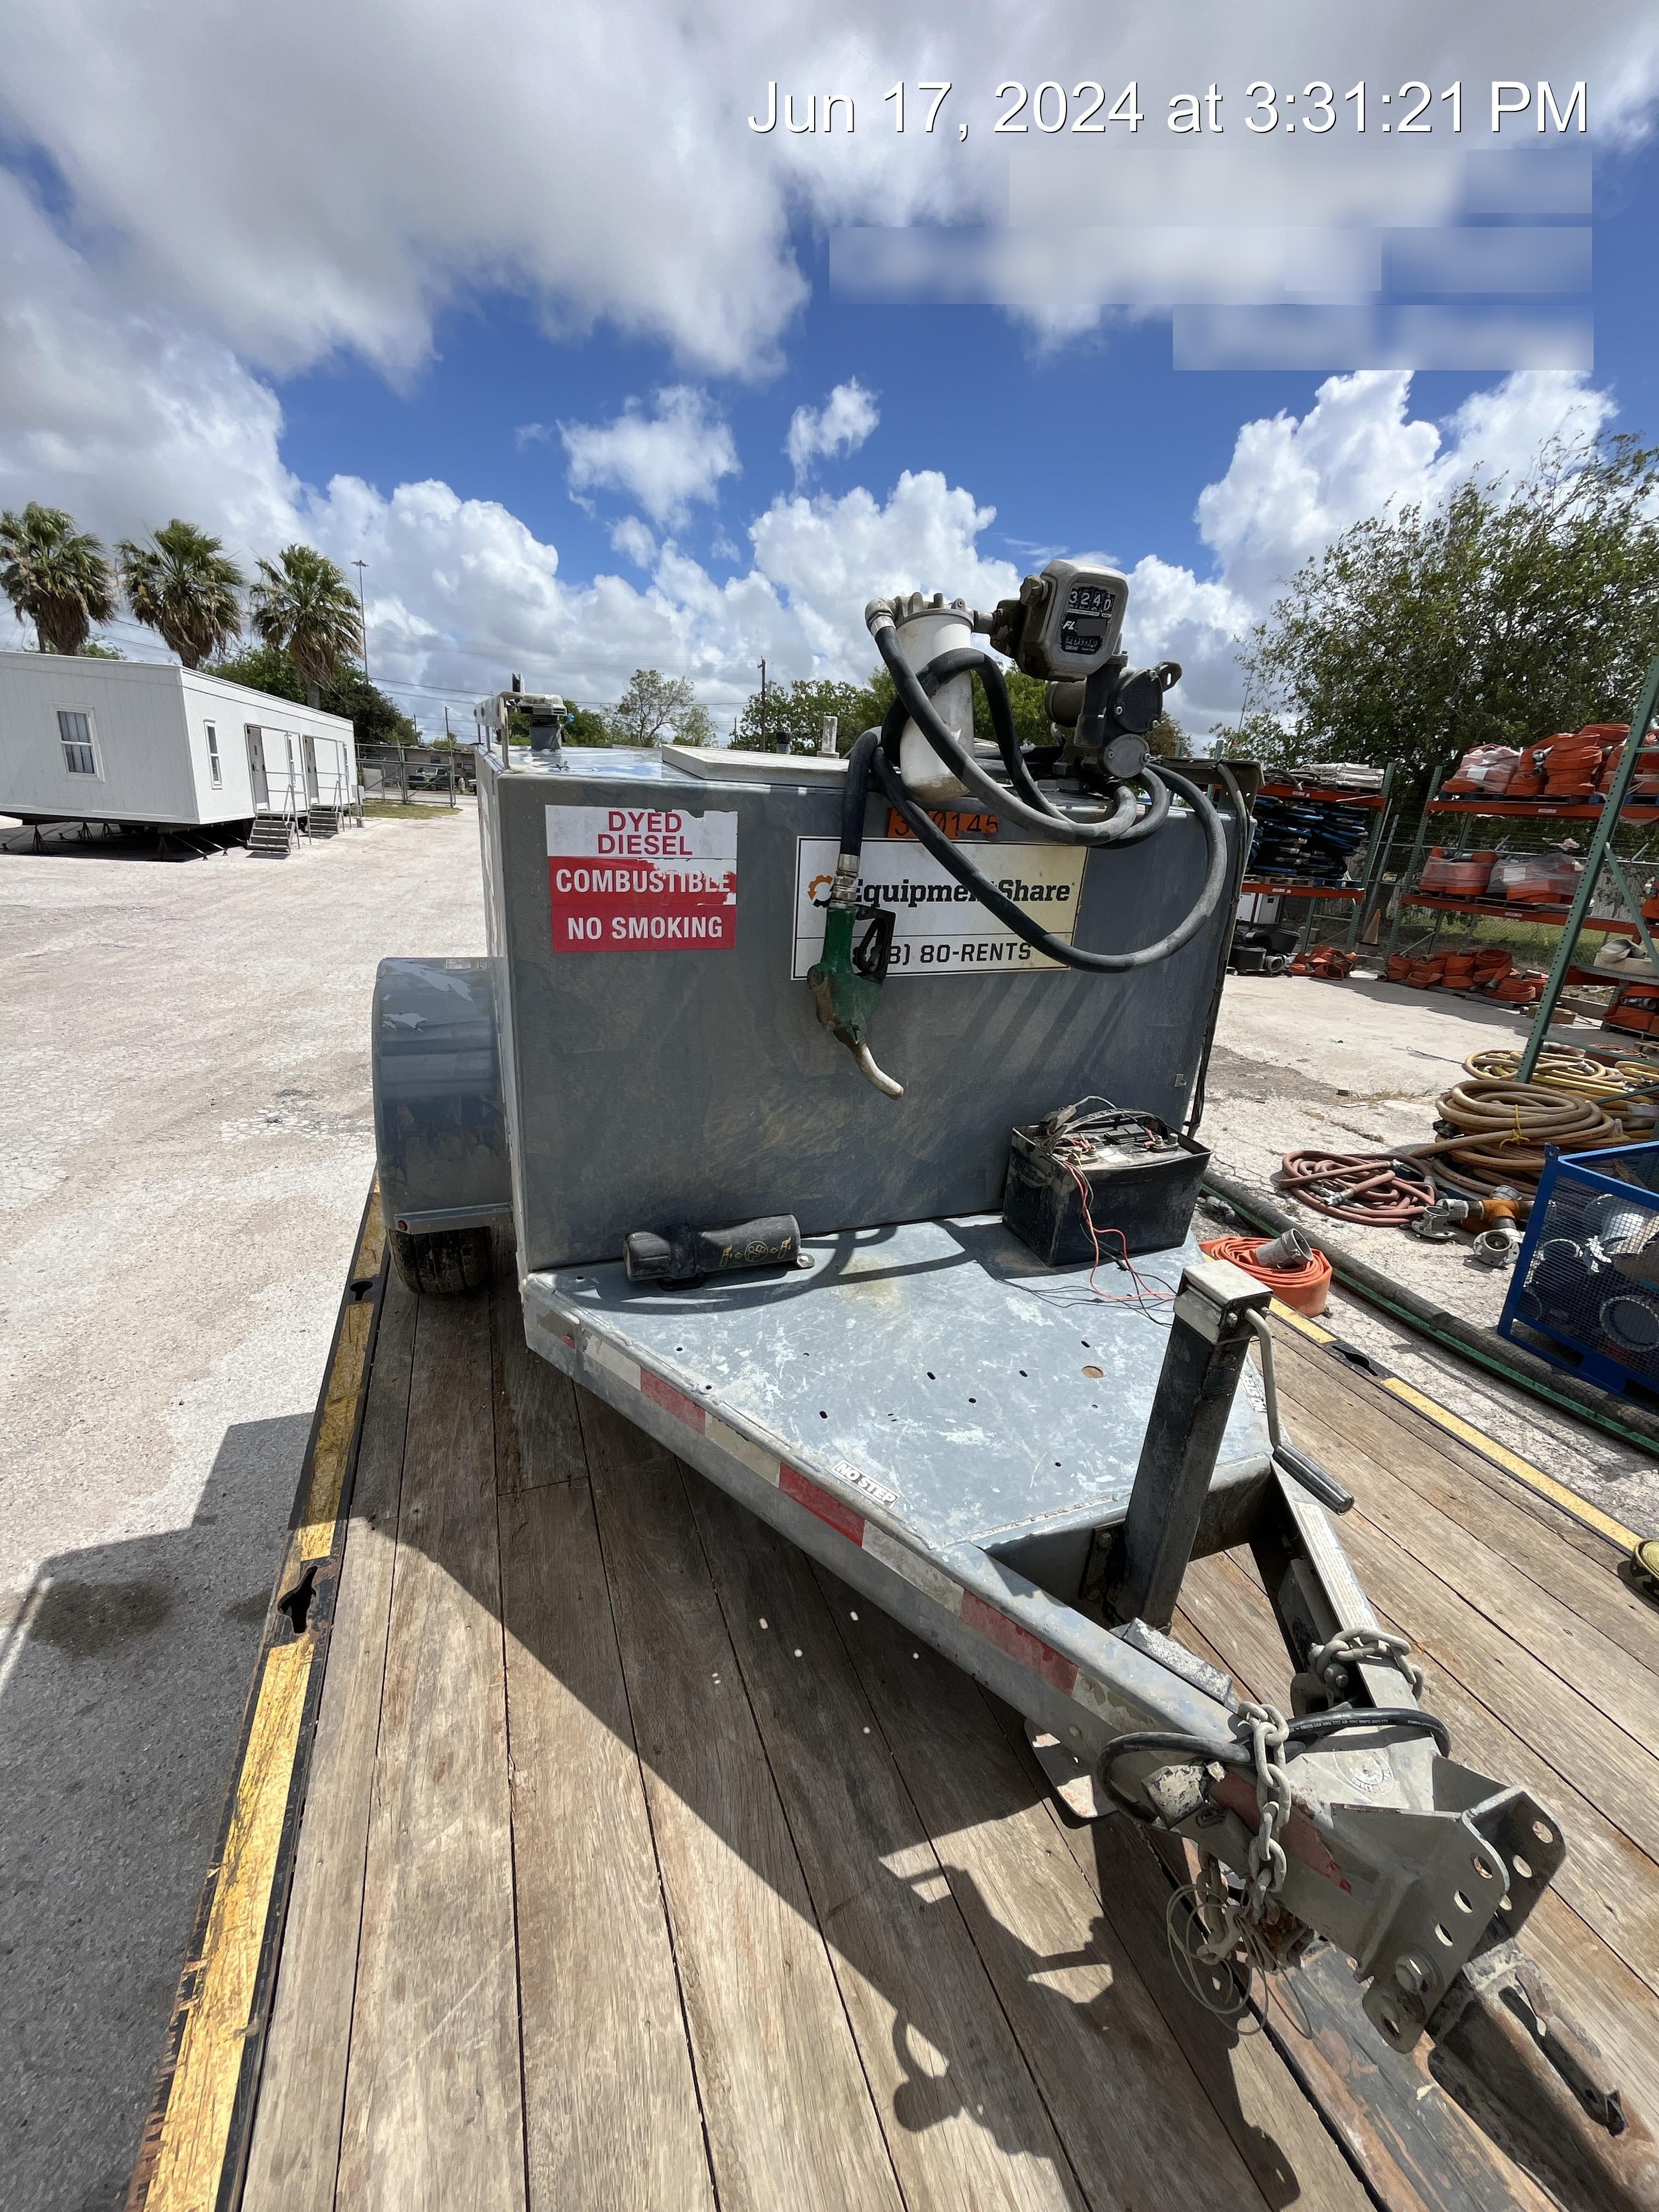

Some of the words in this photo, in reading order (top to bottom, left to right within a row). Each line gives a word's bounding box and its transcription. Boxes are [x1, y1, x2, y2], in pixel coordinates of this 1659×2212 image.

[608, 811, 682, 832] DYED
[894, 811, 1000, 837] 30145
[597, 834, 693, 855] DIESEL
[556, 869, 731, 893] COMBUSTIBLE
[567, 917, 602, 940] NO
[612, 916, 723, 939] SMOKING
[921, 942, 1032, 964] 80-RENTS
[835, 1463, 860, 1481] NO
[857, 1476, 896, 1503] STEP
